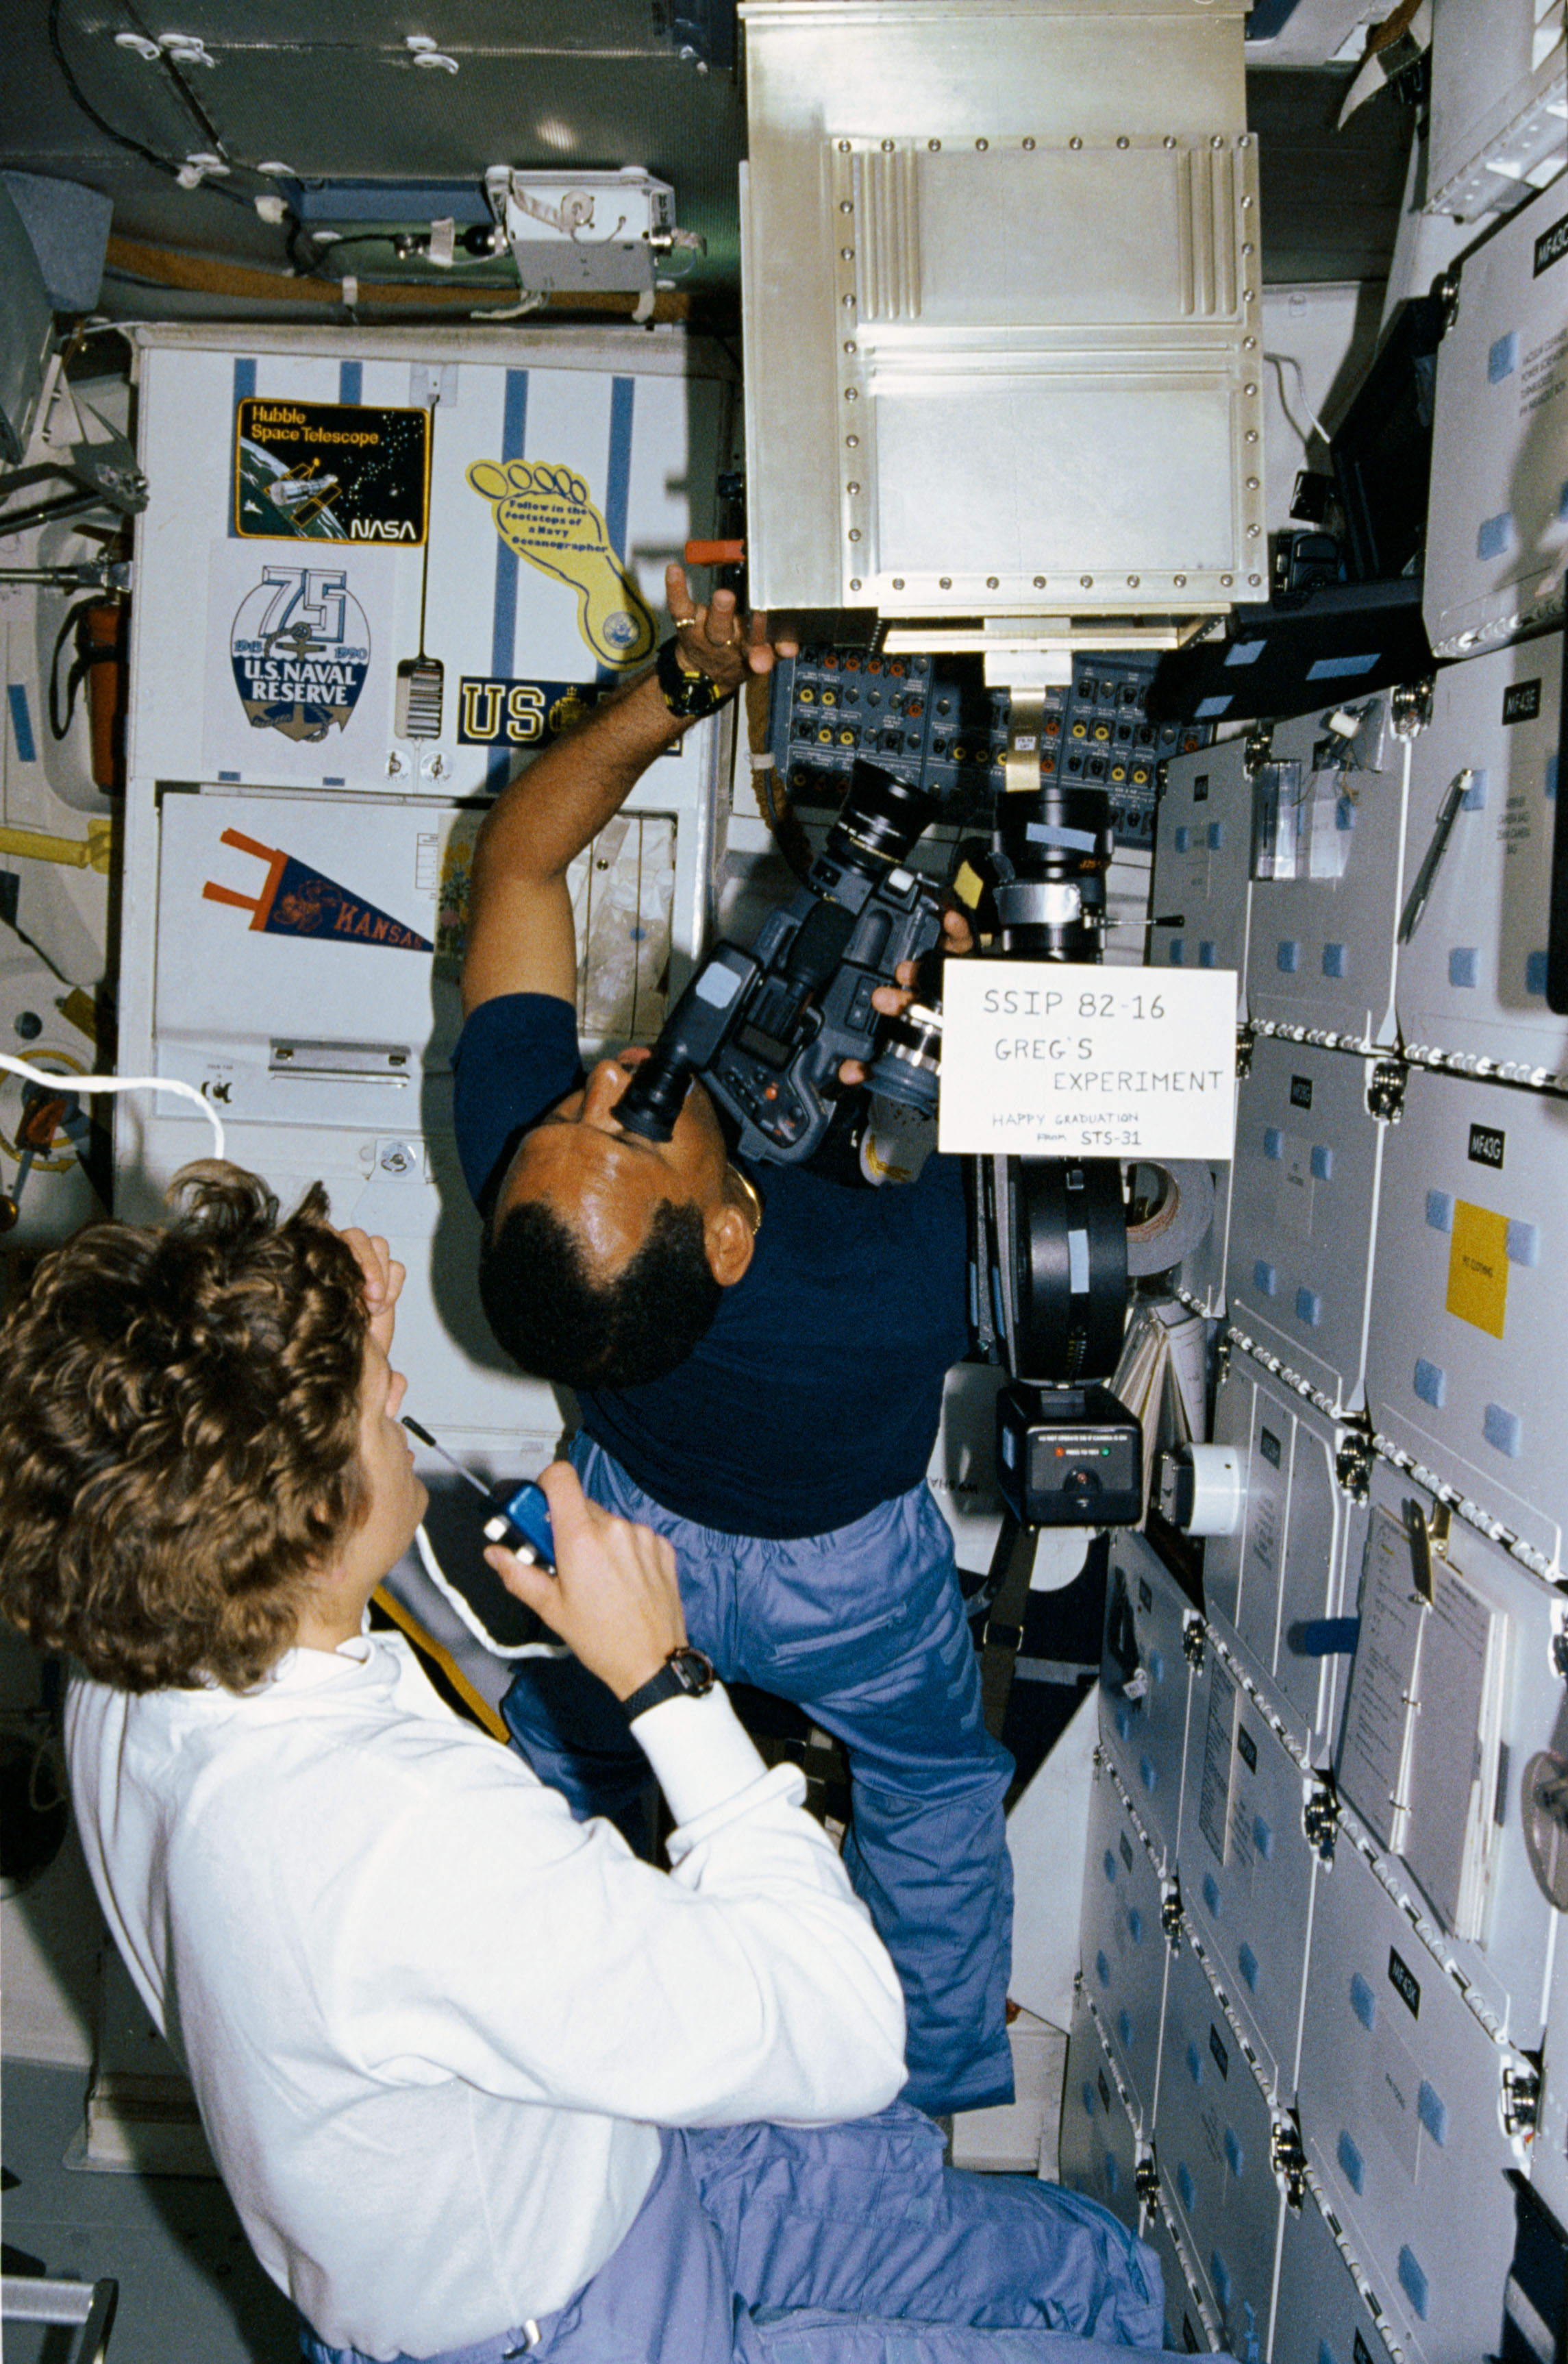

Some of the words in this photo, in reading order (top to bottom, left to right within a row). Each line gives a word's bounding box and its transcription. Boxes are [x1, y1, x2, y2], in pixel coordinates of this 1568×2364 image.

[251, 406, 306, 425] Hubble
[251, 423, 300, 443] Space
[301, 426, 379, 448] Telescope
[509, 500, 549, 511] Follow
[551, 504, 564, 514] in
[567, 506, 587, 515] the
[350, 519, 416, 540] NASA
[538, 527, 569, 539] Navy
[569, 517, 582, 526] of
[511, 535, 609, 553] Oceanographer
[258, 565, 347, 643] 75
[243, 659, 282, 681] U.S.
[283, 662, 356, 686] NAVAL
[251, 680, 349, 706] RESERVE
[334, 900, 424, 949] KANSAS
[983, 989, 1063, 1015] SSIP
[1078, 992, 1166, 1020] 82-16
[994, 1037, 1094, 1061] GREG'S
[1053, 1070, 1224, 1093] EXPERIMENT
[992, 1113, 1045, 1127] HAPPY
[1055, 1112, 1139, 1126] GRADUATION
[1080, 1130, 1142, 1146] STS-31
[1470, 1134, 1502, 1161] MF43G
